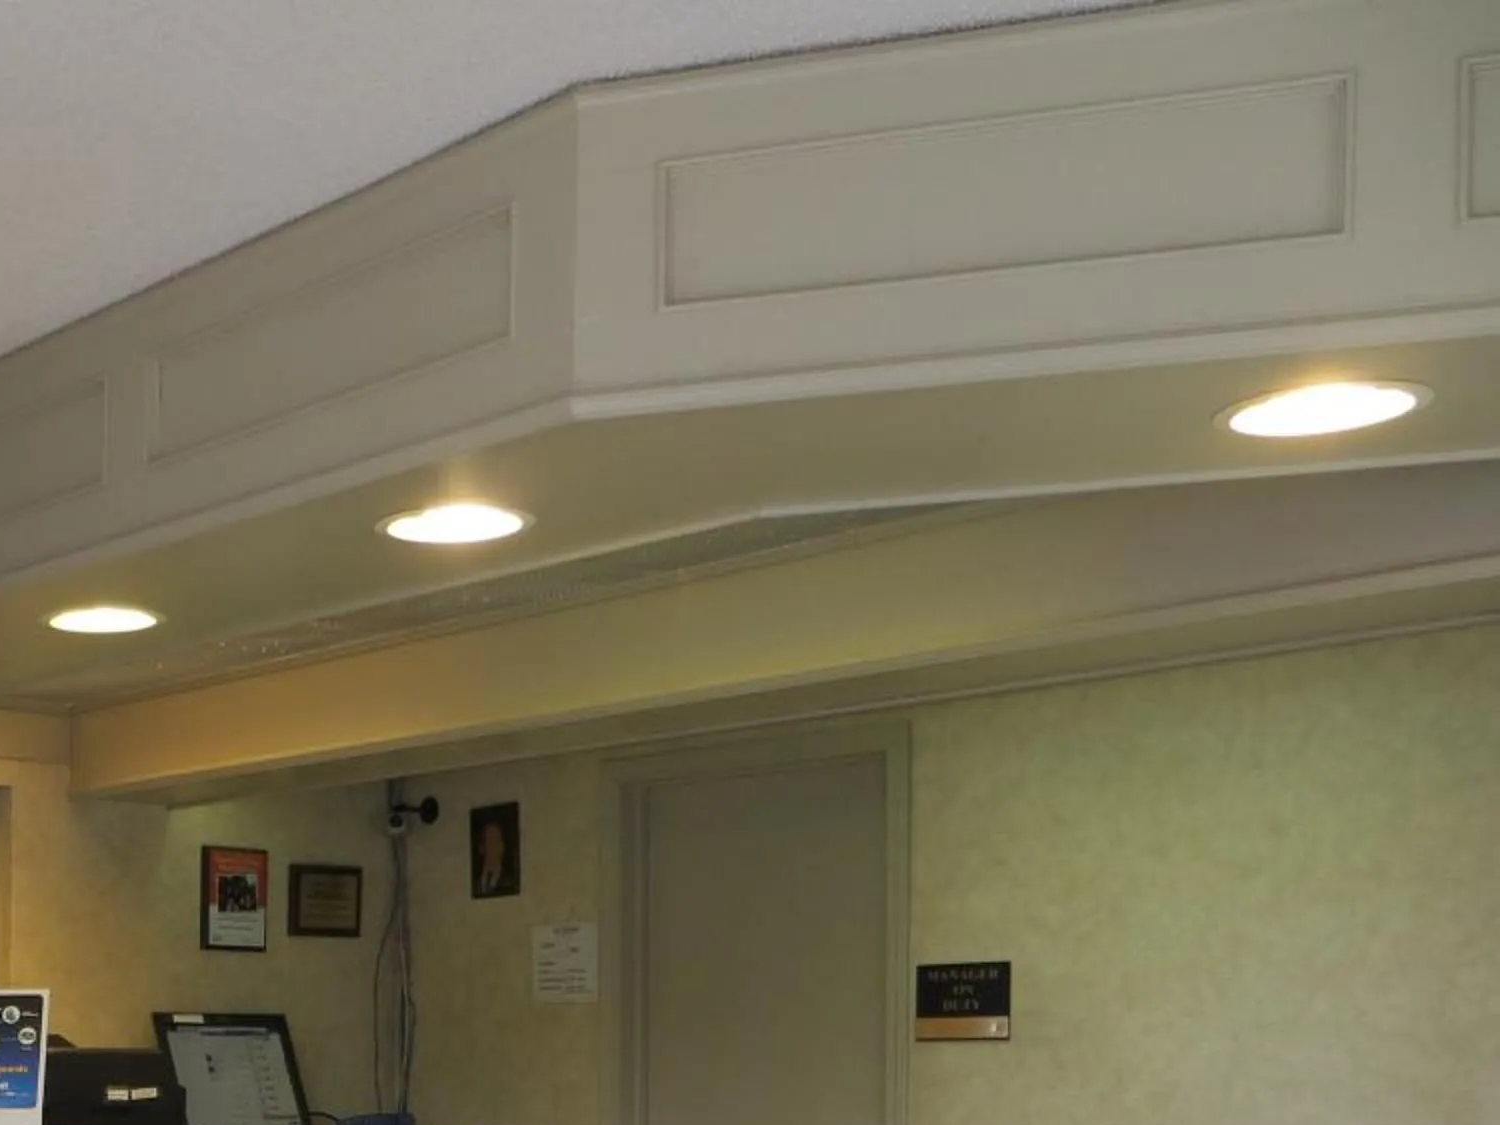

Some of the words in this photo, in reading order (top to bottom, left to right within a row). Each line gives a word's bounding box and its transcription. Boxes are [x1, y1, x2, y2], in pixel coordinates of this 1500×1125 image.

[927, 968, 999, 981] MANAGER
[953, 984, 974, 996] ON
[942, 998, 980, 1012] DUTY
